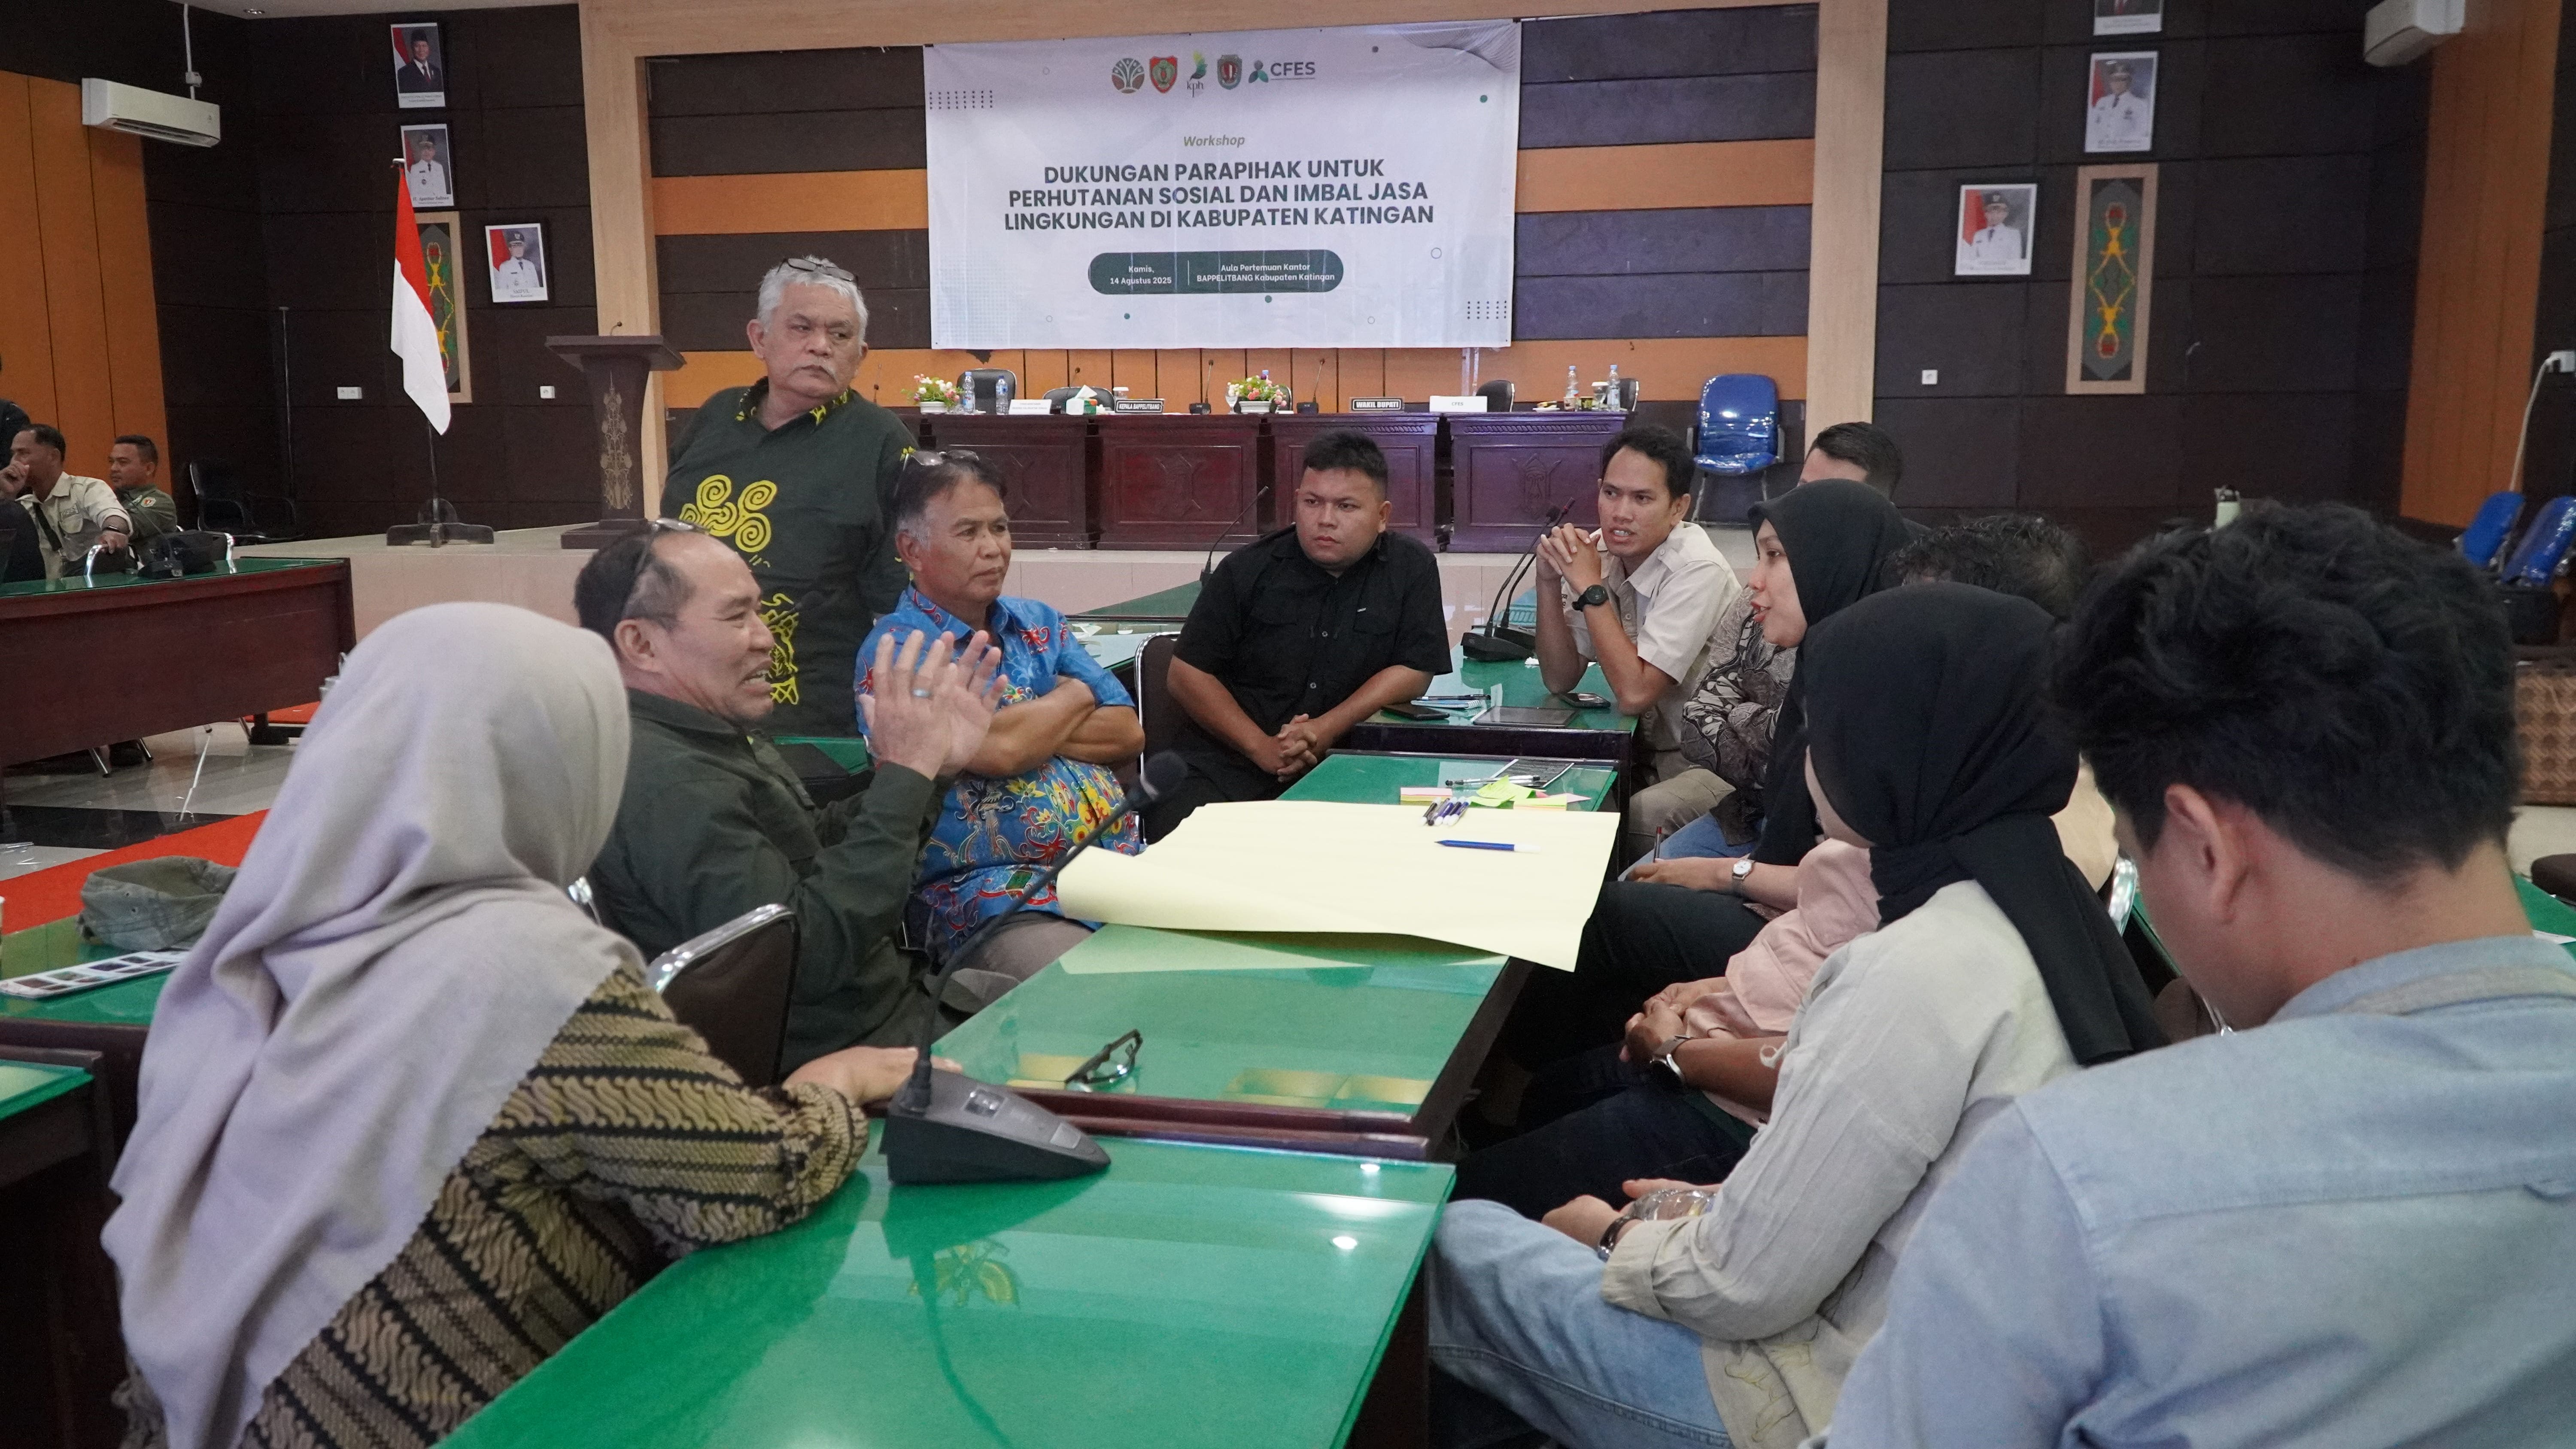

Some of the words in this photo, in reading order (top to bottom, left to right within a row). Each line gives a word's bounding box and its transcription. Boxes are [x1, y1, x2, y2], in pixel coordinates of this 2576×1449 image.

[1270, 61, 1315, 76] CFES
[1187, 80, 1204, 97] kph
[1184, 134, 1245, 148] Workshop
[1044, 164, 1168, 183] DUKUNGAN
[1175, 161, 1302, 181] PARAPIHAK
[1308, 159, 1385, 177] UNTUK
[1009, 188, 1153, 207] PERHUTANAN
[1159, 186, 1235, 204] SOSIAL
[1240, 184, 1288, 203] DAN
[1294, 183, 1363, 201] IMBAL
[1368, 182, 1428, 200] JASA
[1005, 211, 1145, 230] LINGKUNGAN
[1151, 210, 1171, 228] DI
[1178, 207, 1308, 227] KABUPATEN
[1314, 205, 1434, 225] KATINGAN
[1128, 265, 1154, 273] Kamis,
[1240, 264, 1282, 272] Pertemuan
[1121, 277, 1151, 286] Agustus
[1197, 274, 1253, 282] BAPPELITBANG
[1255, 273, 1297, 282] Kabupaten
[1299, 273, 1335, 282] Katingan
